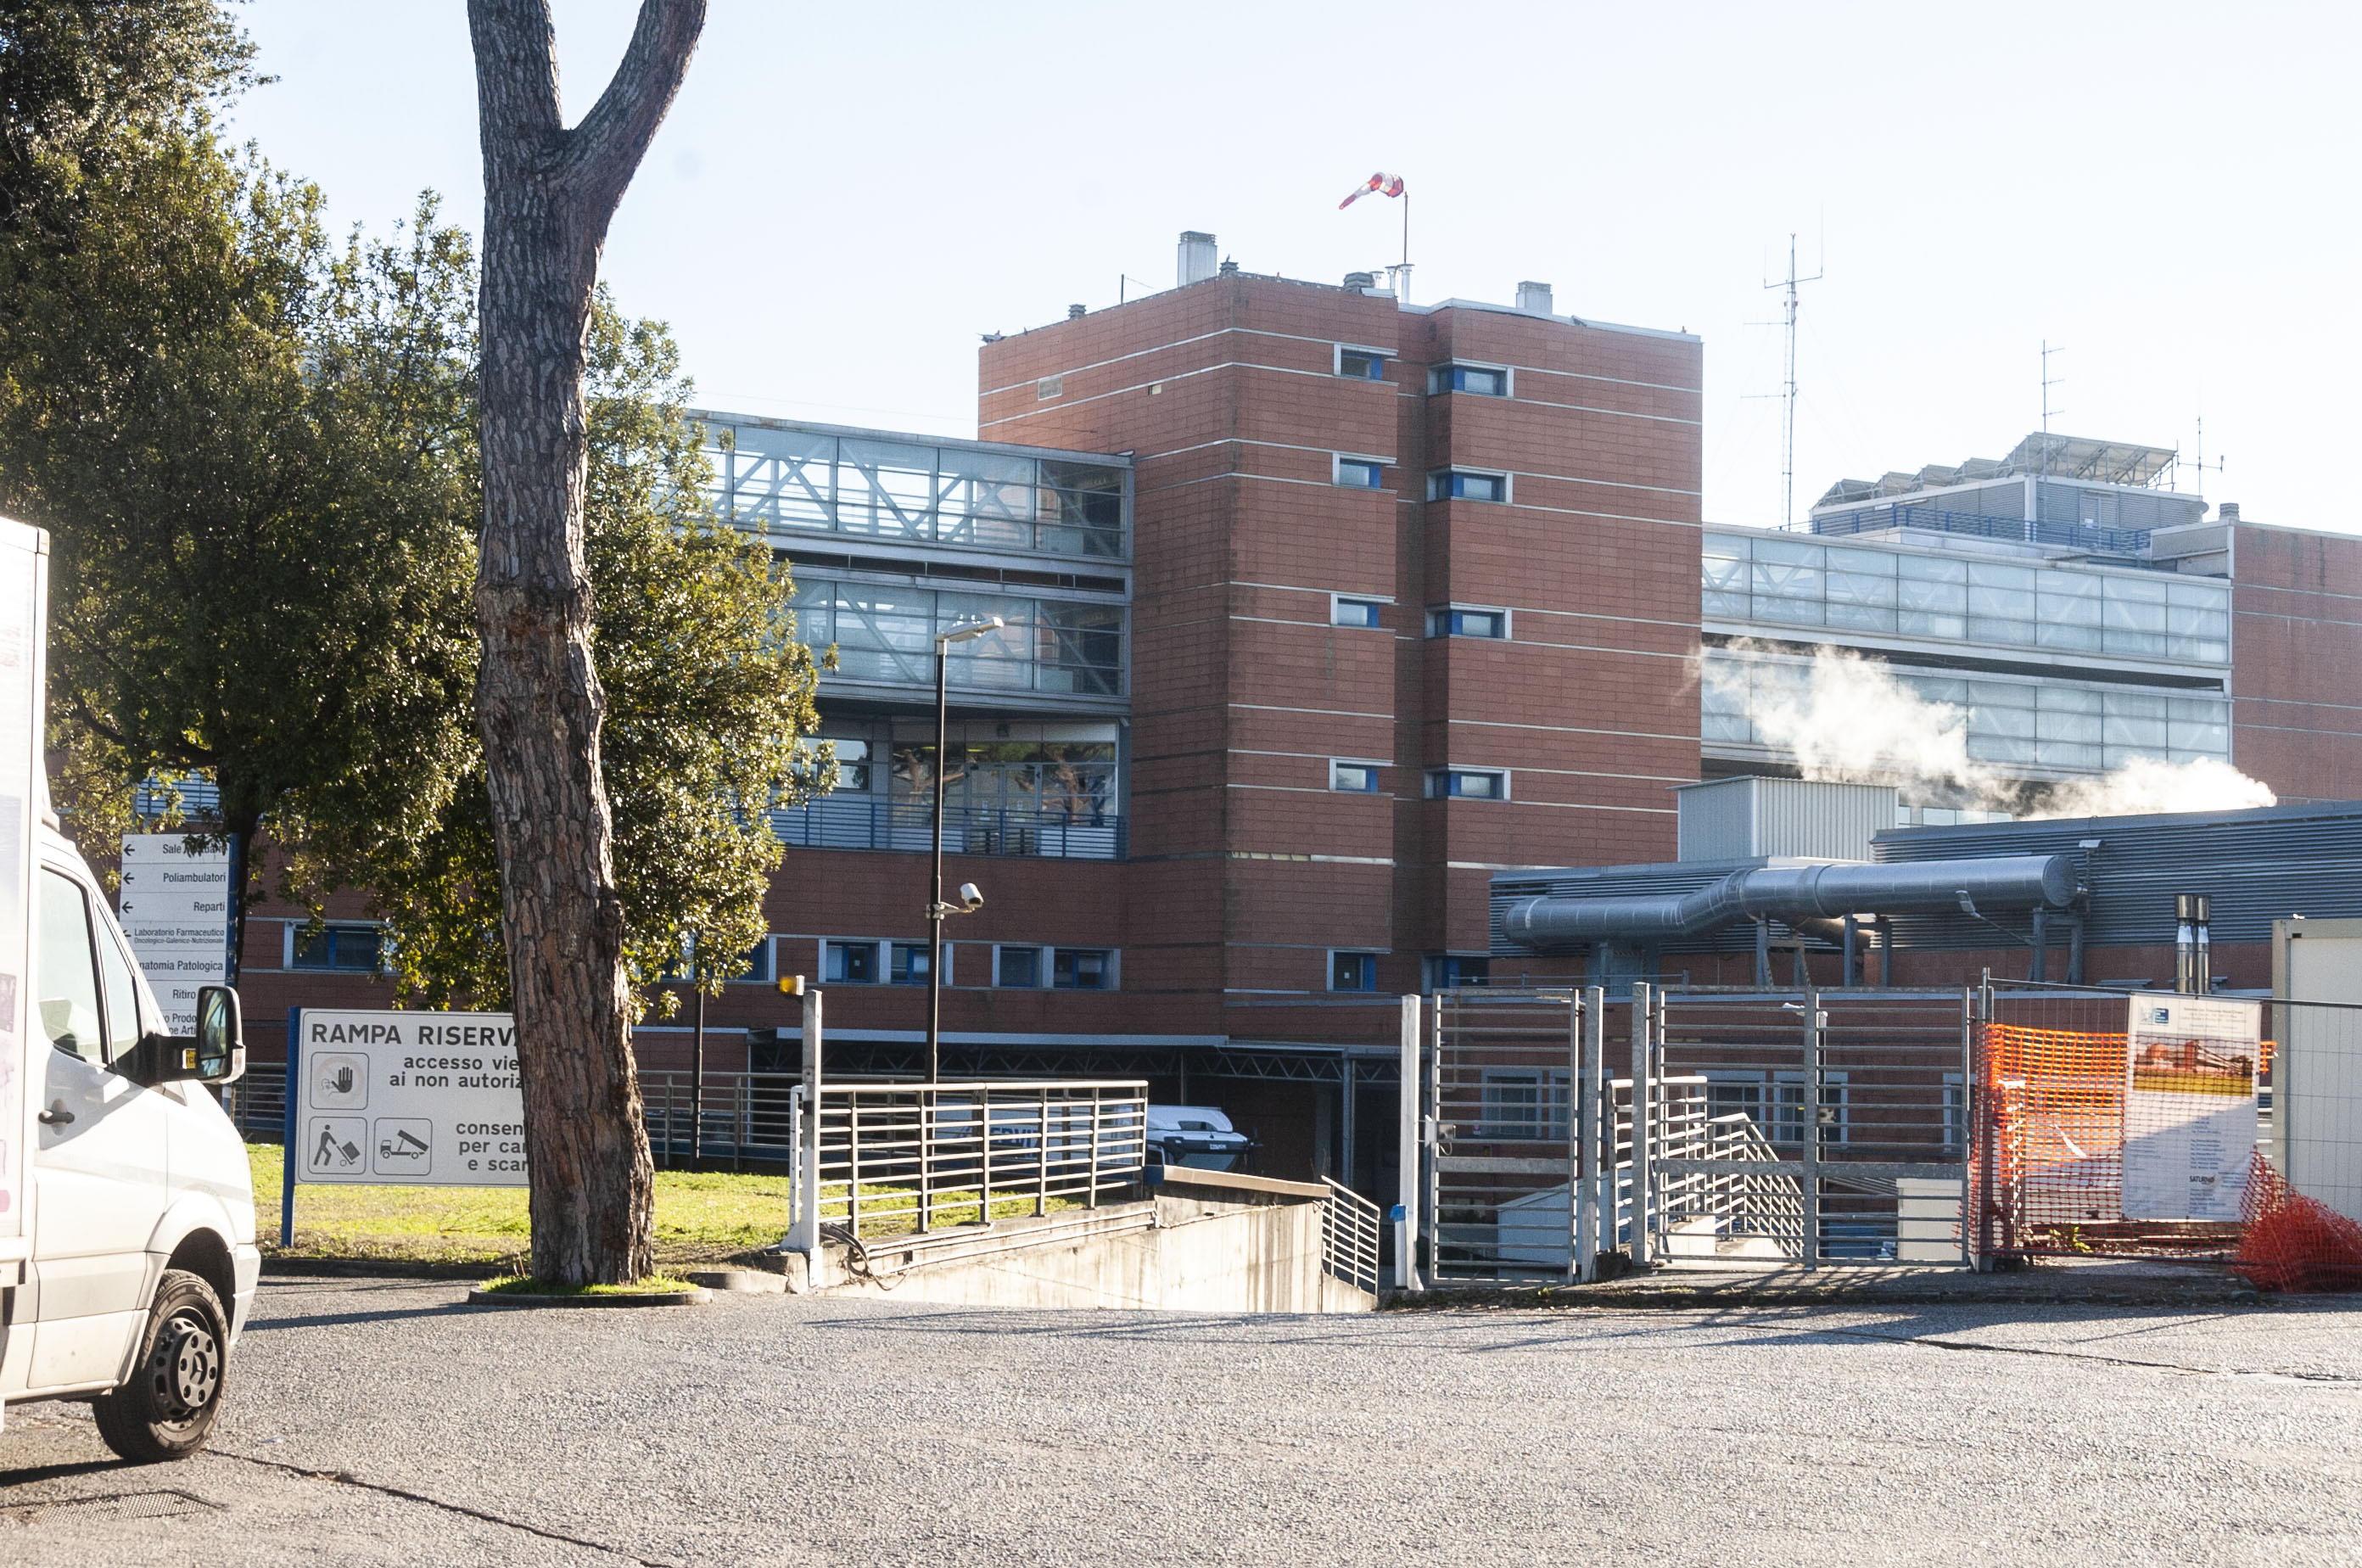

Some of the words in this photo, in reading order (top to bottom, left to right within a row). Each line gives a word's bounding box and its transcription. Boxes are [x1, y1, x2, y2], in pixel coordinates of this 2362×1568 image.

[163, 844, 182, 854] Sale
[163, 872, 226, 882] Poliambulatori
[193, 901, 226, 912] Reparti
[134, 928, 175, 937] Laboratorio
[176, 928, 224, 937] Farmaceutico
[176, 960, 223, 972] Patologica
[172, 988, 196, 999] Ritiro
[311, 1023, 401, 1044] RAMPA
[418, 1026, 518, 1047] RISERV
[404, 1056, 483, 1070] accesso
[389, 1072, 406, 1086] ai
[415, 1074, 449, 1087] non
[456, 1123, 523, 1135] consen
[459, 1141, 490, 1156] per
[467, 1159, 478, 1170] e
